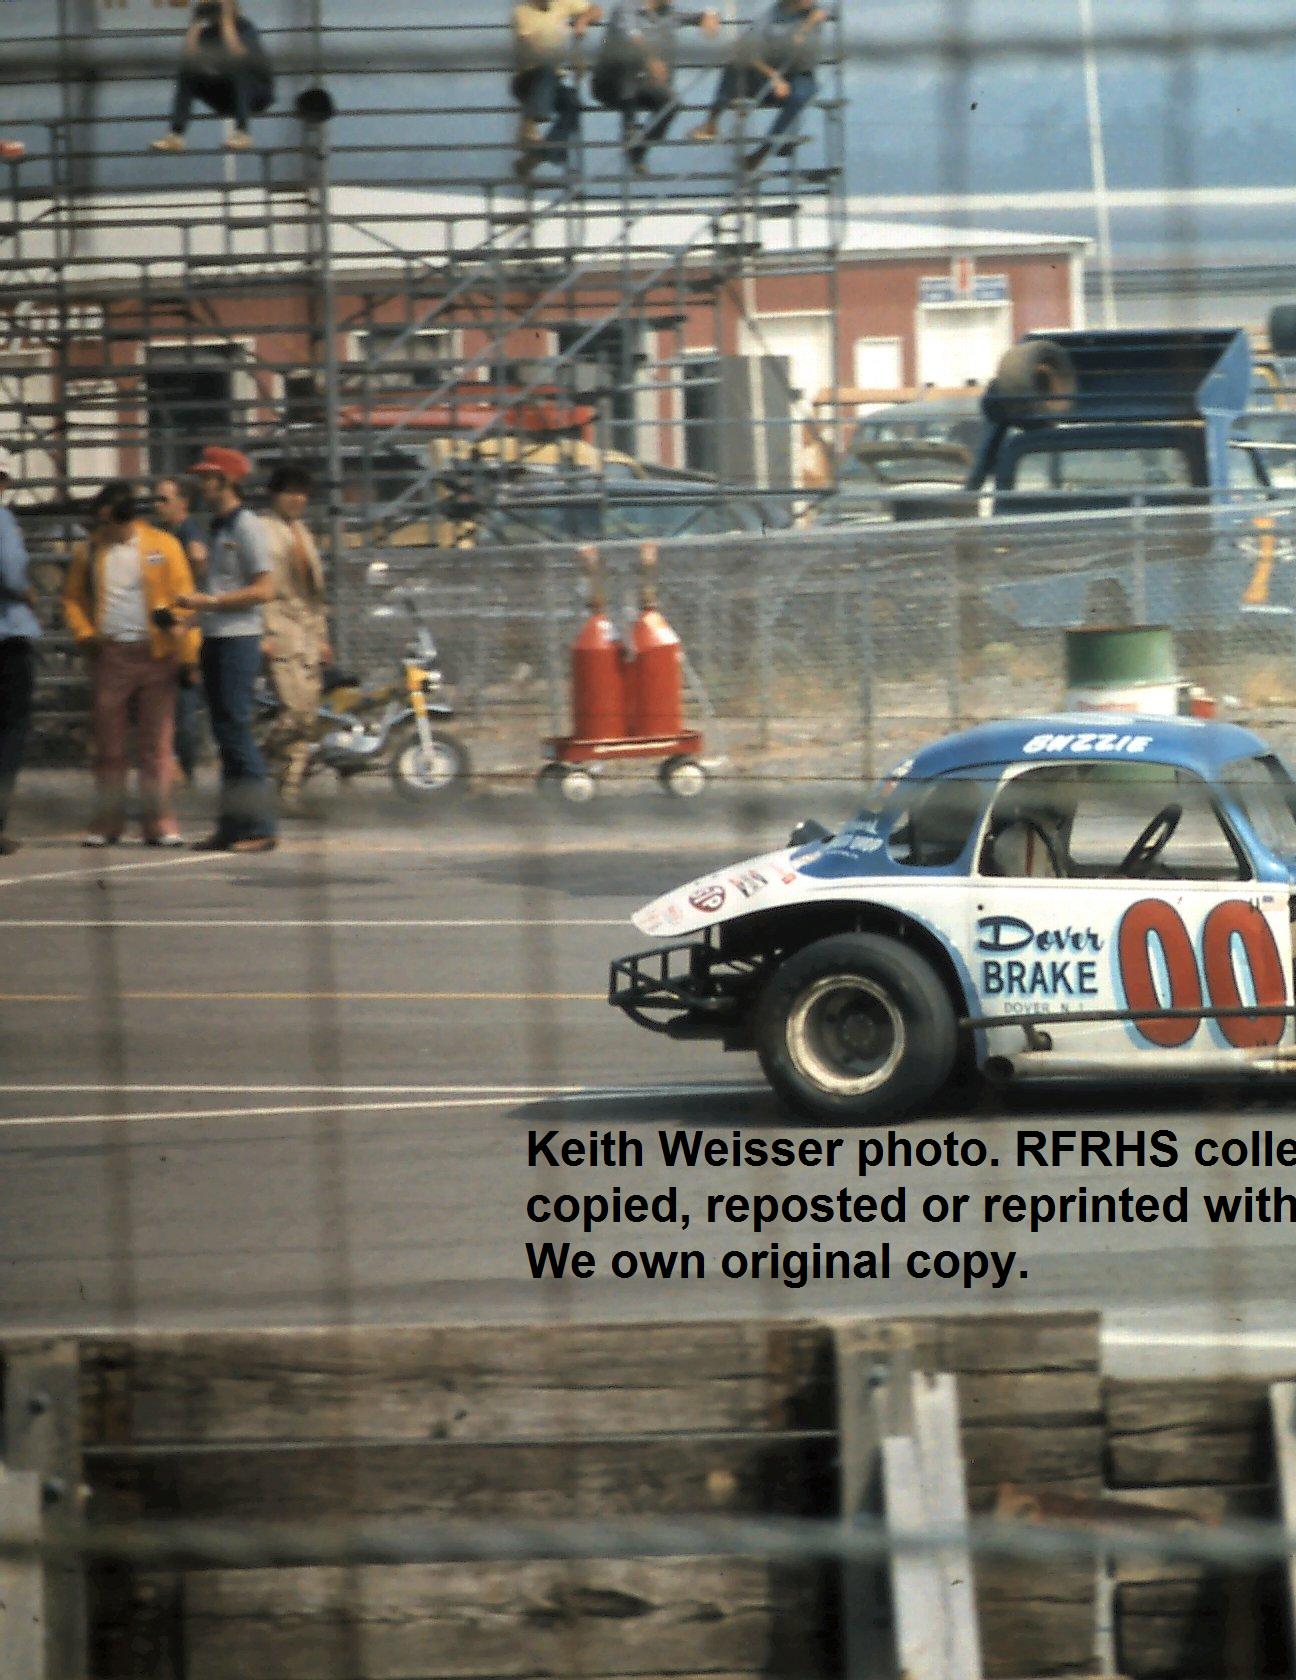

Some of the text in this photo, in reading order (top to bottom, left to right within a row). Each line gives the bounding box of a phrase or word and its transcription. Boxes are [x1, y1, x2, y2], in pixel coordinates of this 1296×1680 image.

[976, 915, 1105, 952] Dover
[983, 960, 1099, 995] BRAKE
[1116, 897, 1288, 1050] 00
